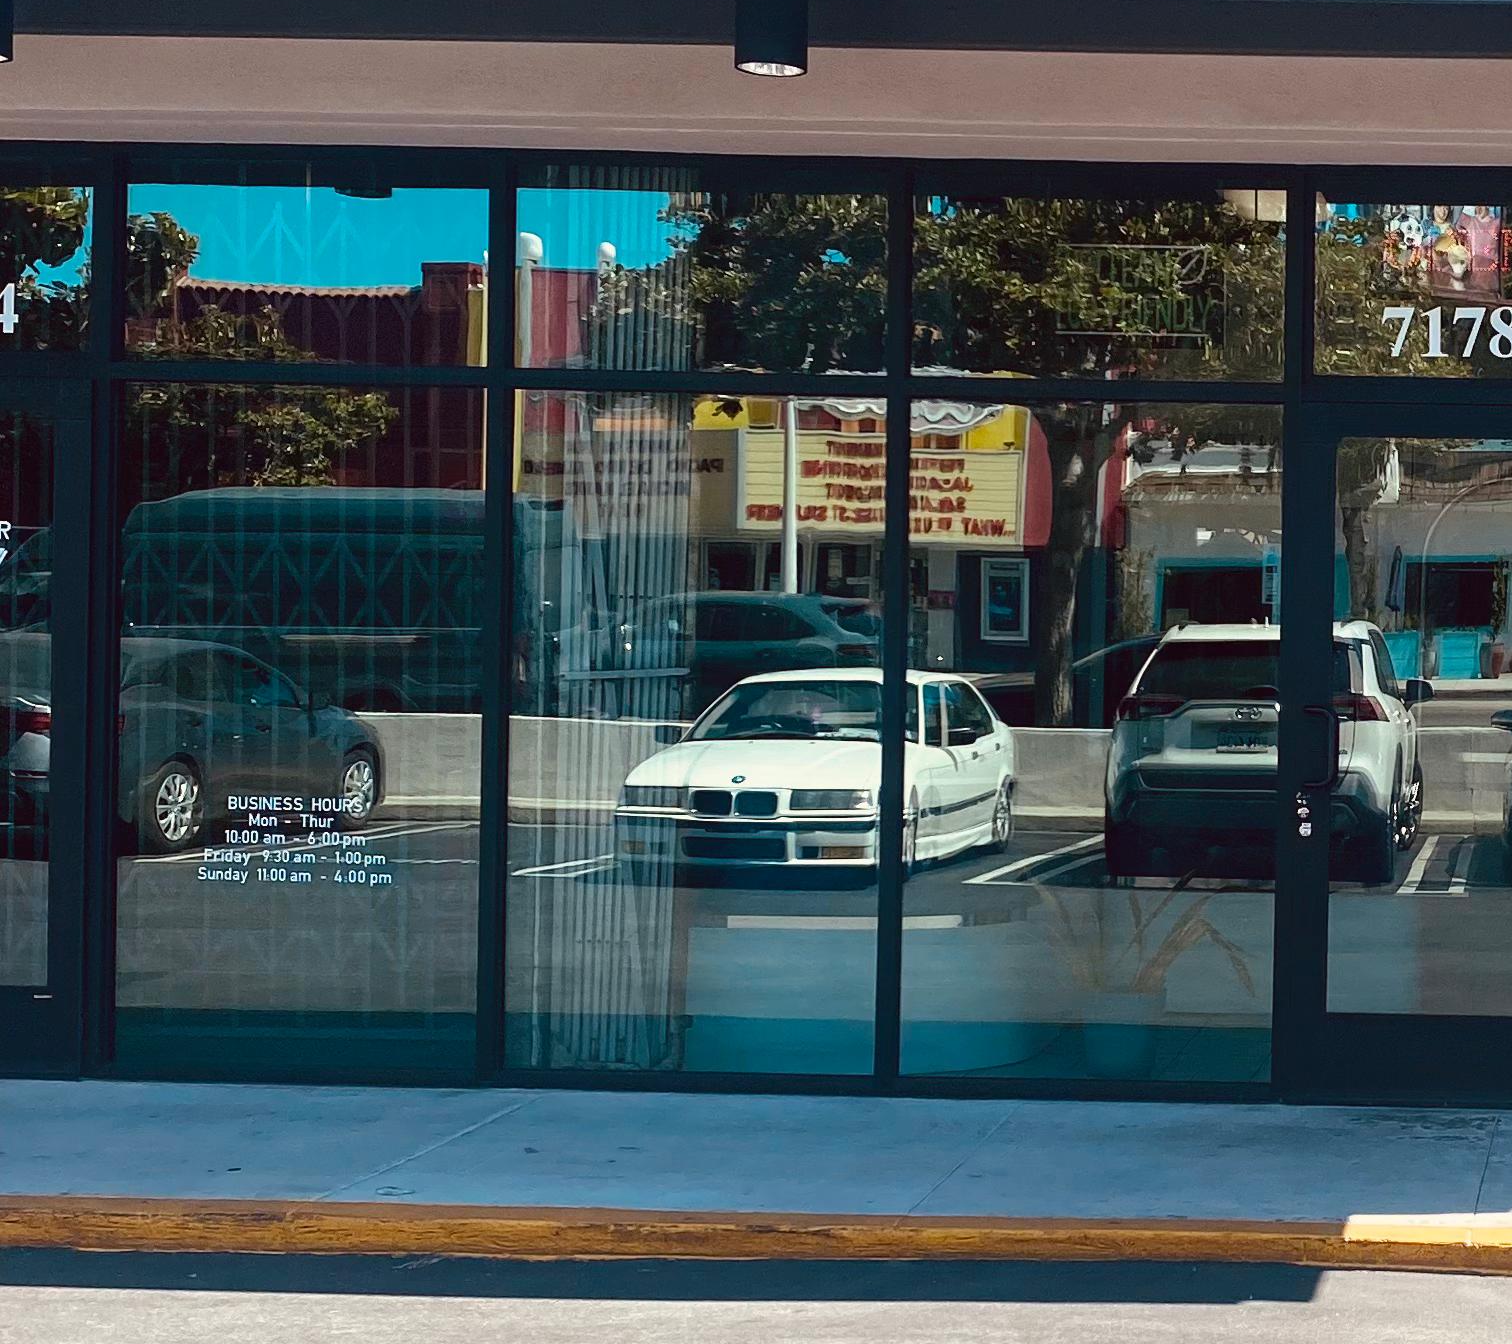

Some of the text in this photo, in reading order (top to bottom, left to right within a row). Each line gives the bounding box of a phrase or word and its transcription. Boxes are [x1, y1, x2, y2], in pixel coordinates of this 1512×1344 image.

[228, 795, 364, 813] BUSINESS HOURS
[248, 813, 278, 828] Mon
[300, 813, 335, 829] Thur
[224, 829, 259, 845] 10:00
[263, 834, 286, 845] am
[307, 831, 340, 846] 6:00
[342, 835, 366, 850] pm
[203, 848, 251, 867] Friday
[262, 849, 290, 864] 9:30
[294, 853, 316, 865] am
[334, 851, 362, 865] 1:00
[364, 855, 386, 867] pm
[197, 866, 249, 885] Sunday
[256, 868, 287, 883] 11:00
[290, 871, 312, 883] am
[333, 870, 366, 884] 4:00
[370, 874, 392, 887] pm
